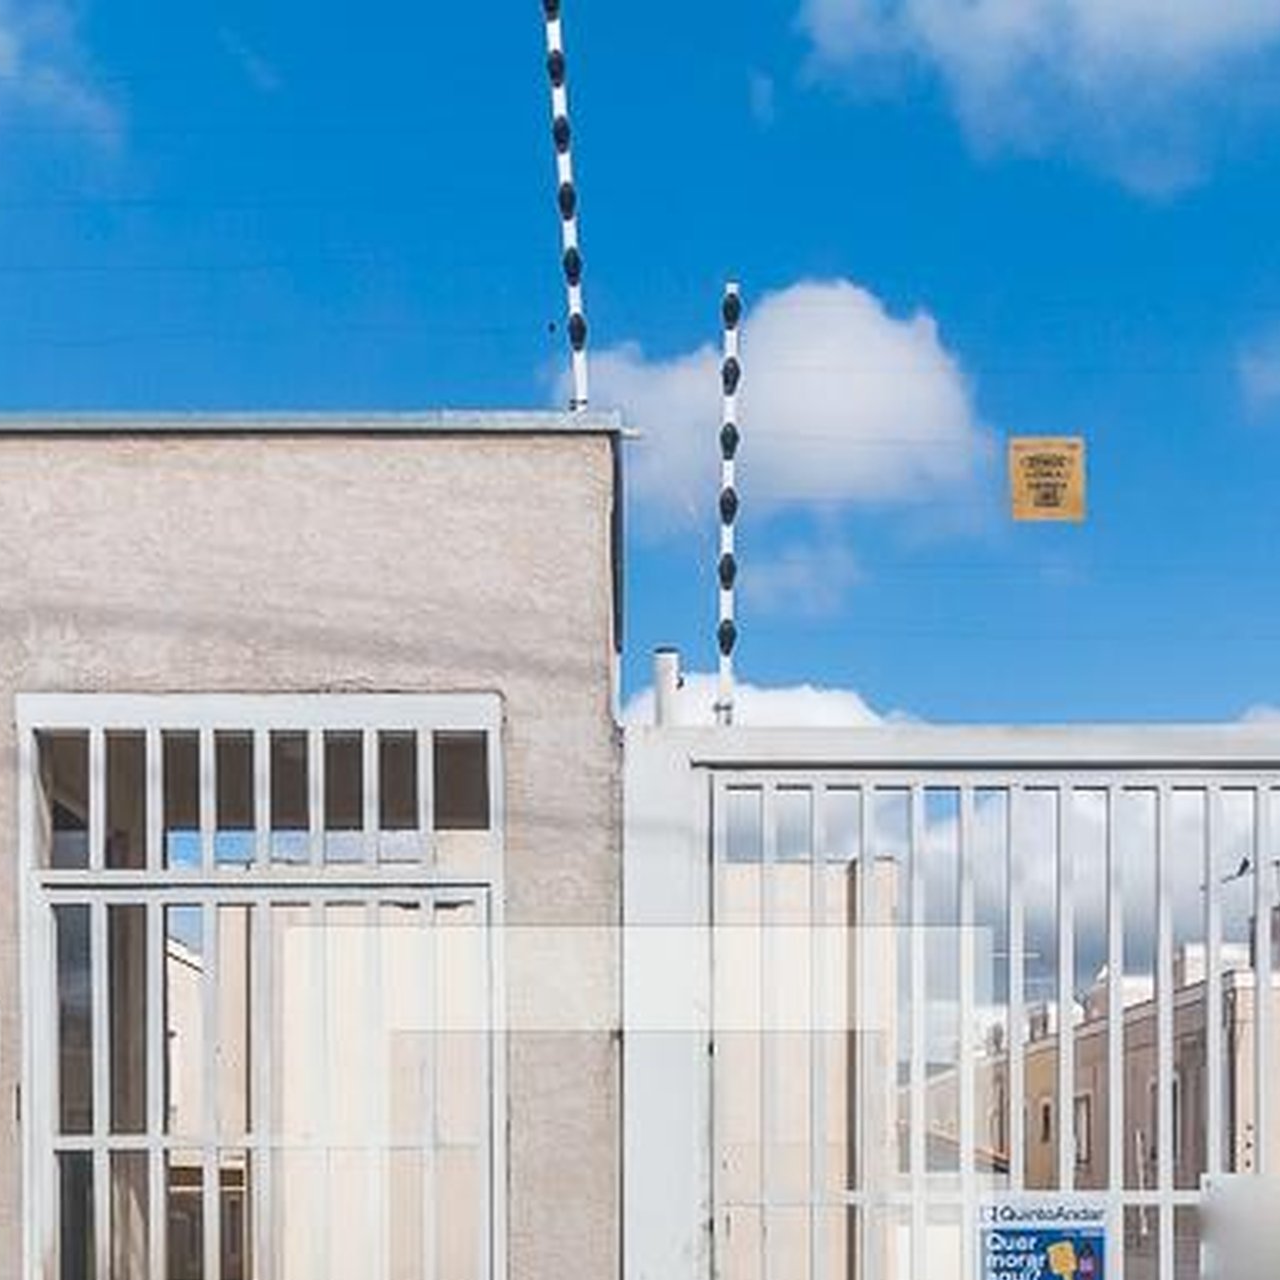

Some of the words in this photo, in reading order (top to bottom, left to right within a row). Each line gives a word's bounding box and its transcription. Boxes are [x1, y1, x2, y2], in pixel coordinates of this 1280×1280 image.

[1000, 1205, 1105, 1222] QuintoAndar
[985, 1232, 1038, 1251] Quer
[985, 1252, 1046, 1269] morar
